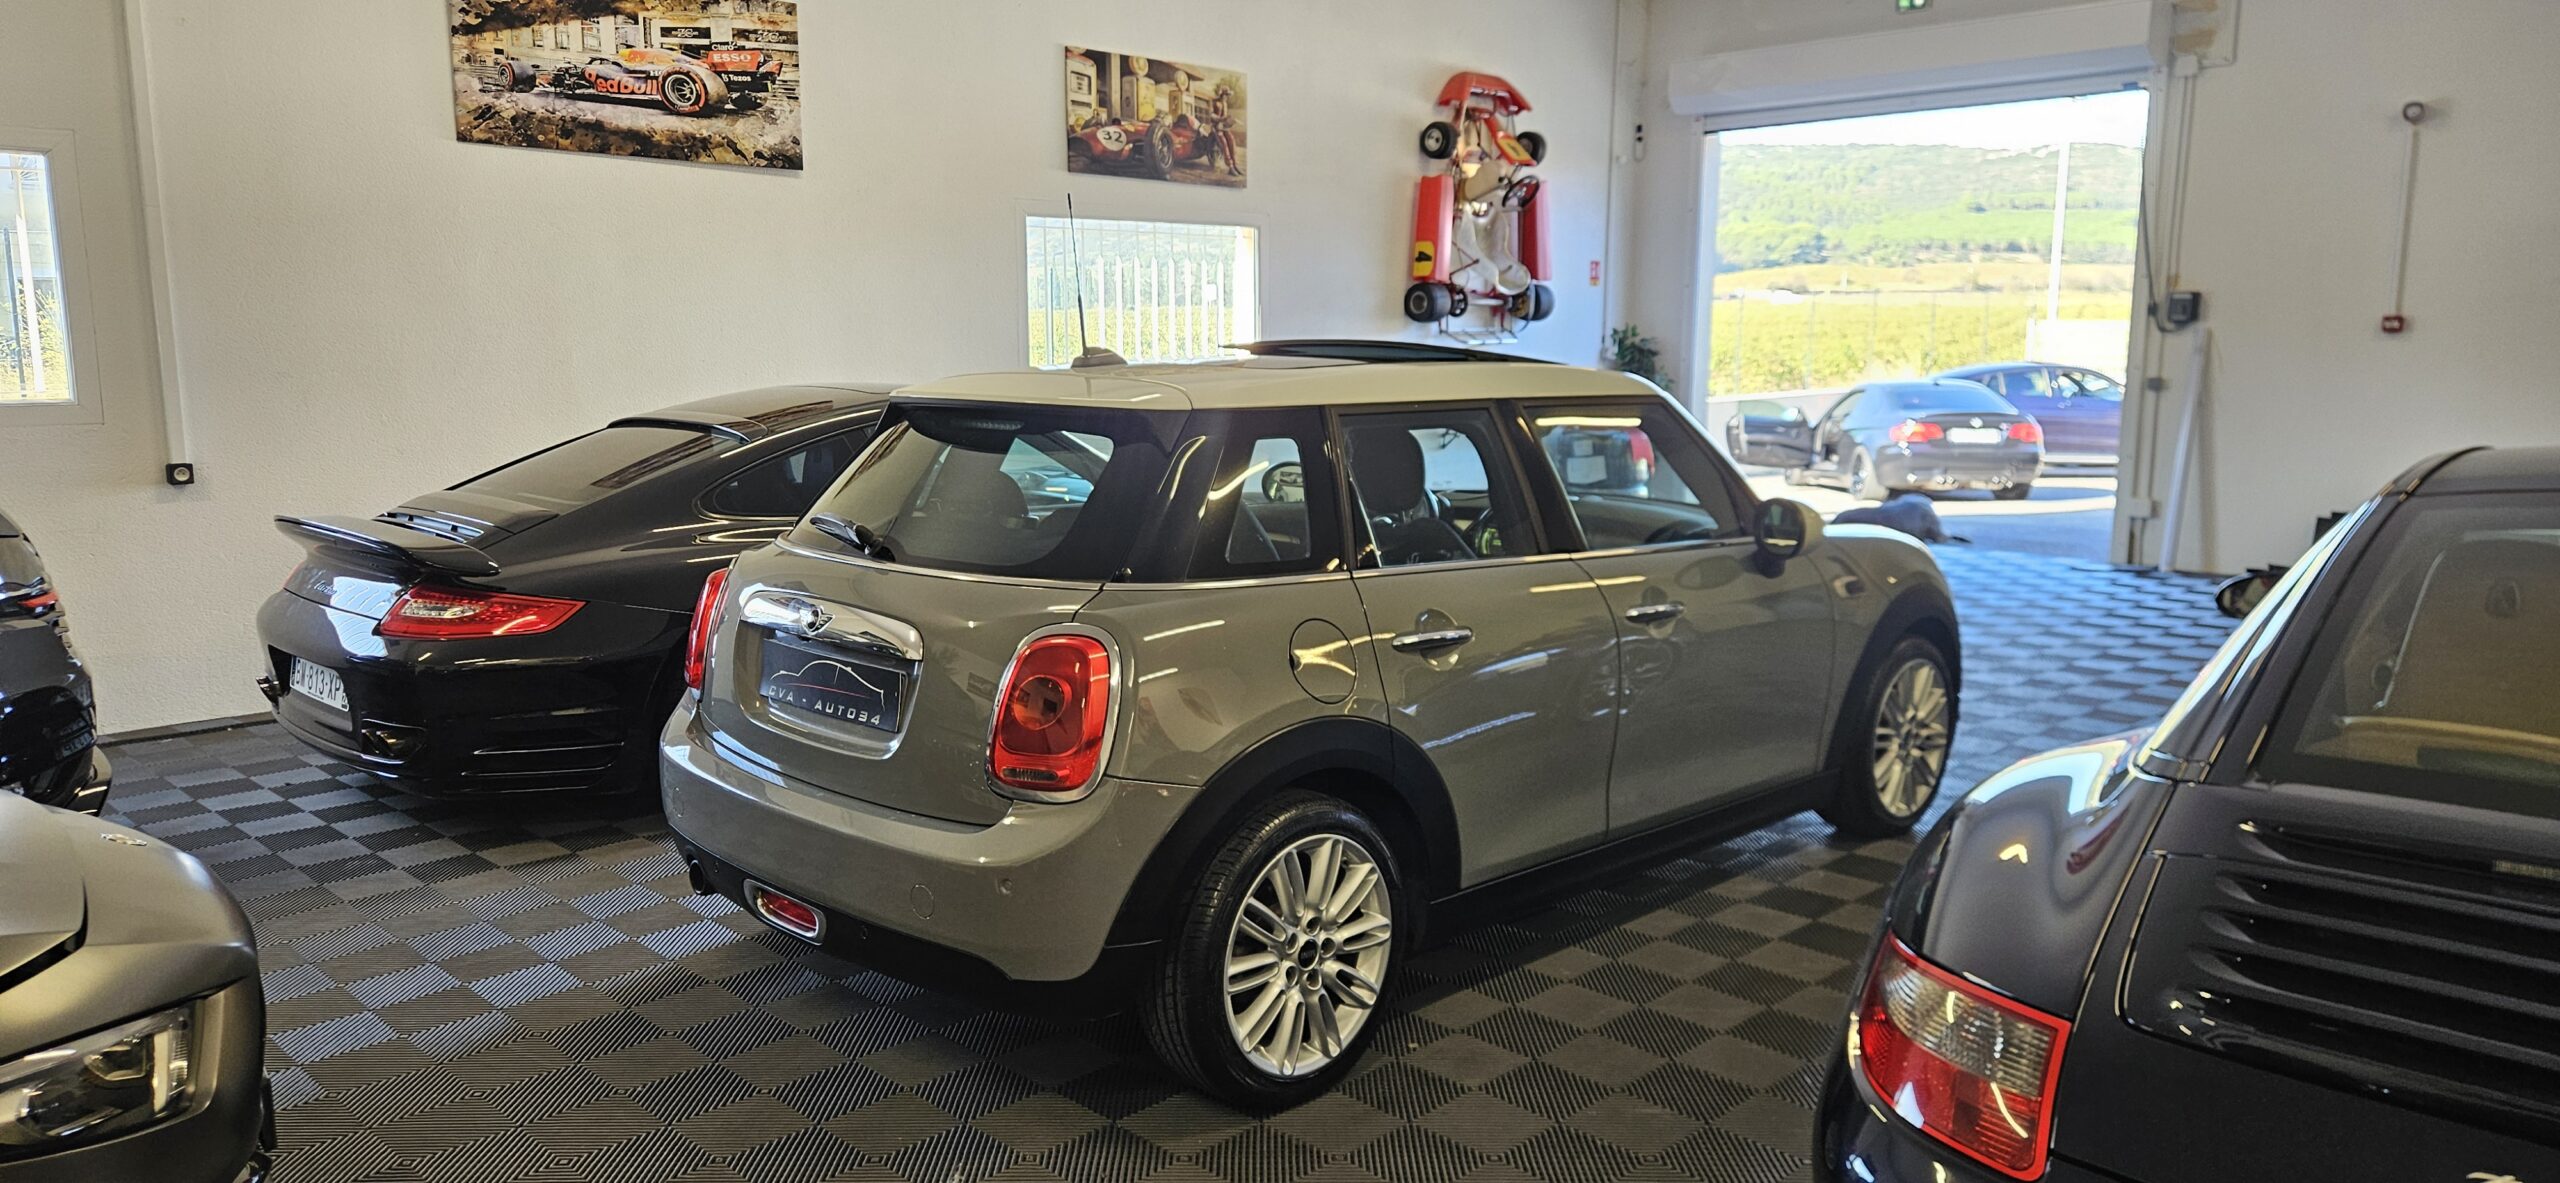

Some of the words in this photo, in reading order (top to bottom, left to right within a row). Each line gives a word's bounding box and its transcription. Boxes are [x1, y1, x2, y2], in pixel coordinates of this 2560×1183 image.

[713, 54, 752, 63] ESSO
[728, 74, 752, 82] Tezos
[1102, 130, 1124, 144] 32
[814, 699, 881, 725] AUTO34
